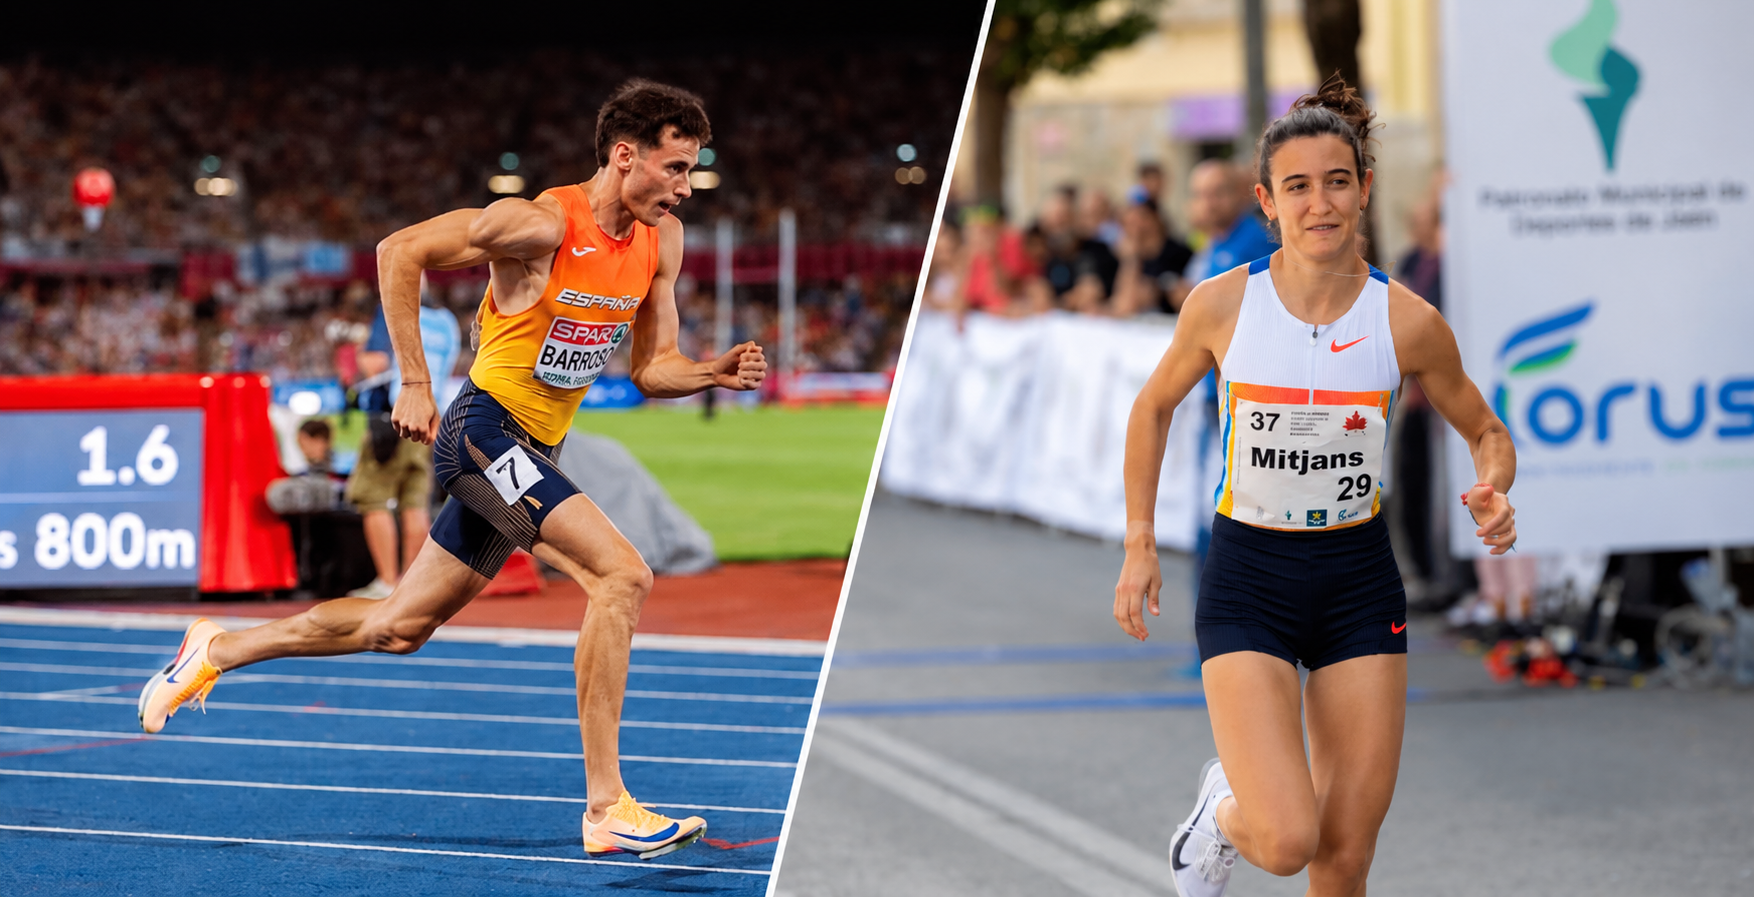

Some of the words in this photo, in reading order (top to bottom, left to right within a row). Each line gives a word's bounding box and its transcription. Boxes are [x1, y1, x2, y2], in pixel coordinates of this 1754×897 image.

[555, 287, 641, 311] ESPAÑA
[553, 322, 614, 345] SPAR
[540, 344, 615, 371] BARROSO
[1250, 411, 1281, 432] 37
[77, 424, 179, 486] 1.6
[1251, 446, 1364, 475] Mitjans
[495, 457, 520, 490] 7
[1337, 473, 1372, 502] 29
[34, 512, 196, 570] 800m
